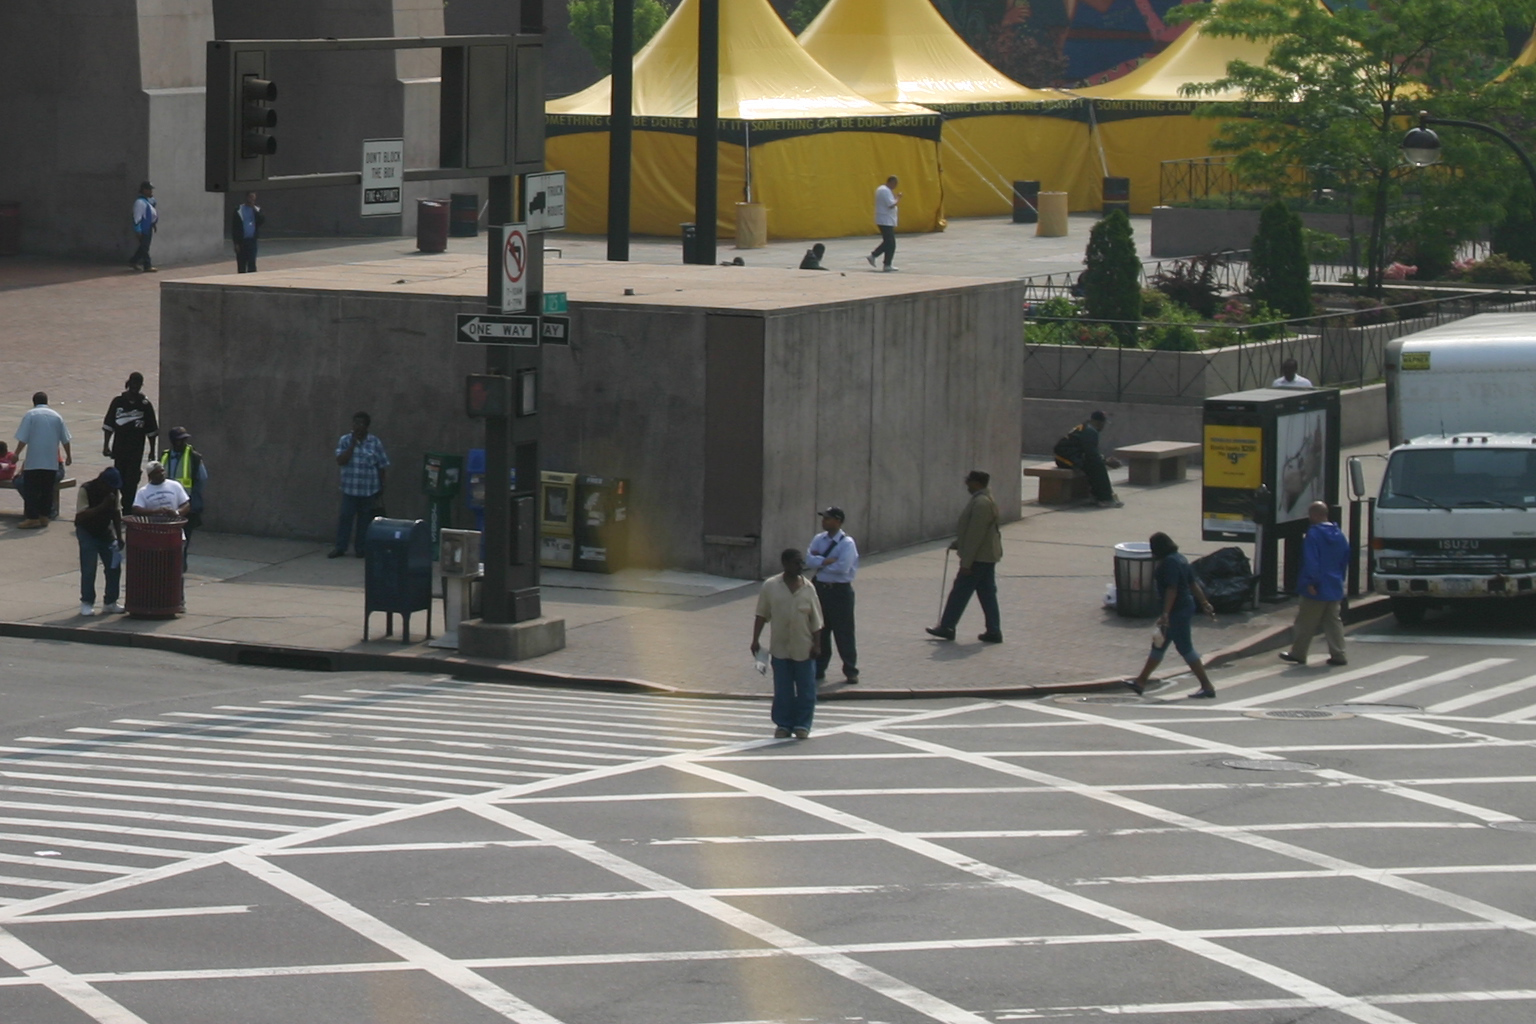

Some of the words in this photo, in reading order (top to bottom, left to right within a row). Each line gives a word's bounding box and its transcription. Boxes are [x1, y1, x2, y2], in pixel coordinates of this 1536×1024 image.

[1096, 101, 1164, 111] SOMETHING
[1168, 101, 1191, 111] CAN
[633, 116, 648, 127] BE
[651, 117, 683, 129] DONE
[751, 118, 814, 132] SOMETHING
[817, 117, 838, 129] CAN
[841, 117, 854, 128] BE
[857, 116, 887, 128] DONE
[889, 116, 923, 127] ABOUT
[926, 116, 936, 126] IT
[383, 151, 401, 163] BLOCK
[371, 167, 382, 178] THE
[383, 167, 395, 178] BOX
[547, 185, 563, 197] TRUCK
[547, 205, 564, 217] ROUTE
[469, 324, 492, 336] ONE
[502, 325, 528, 337] WAY
[544, 325, 560, 336] AY
[1438, 539, 1480, 549] ISUZU
